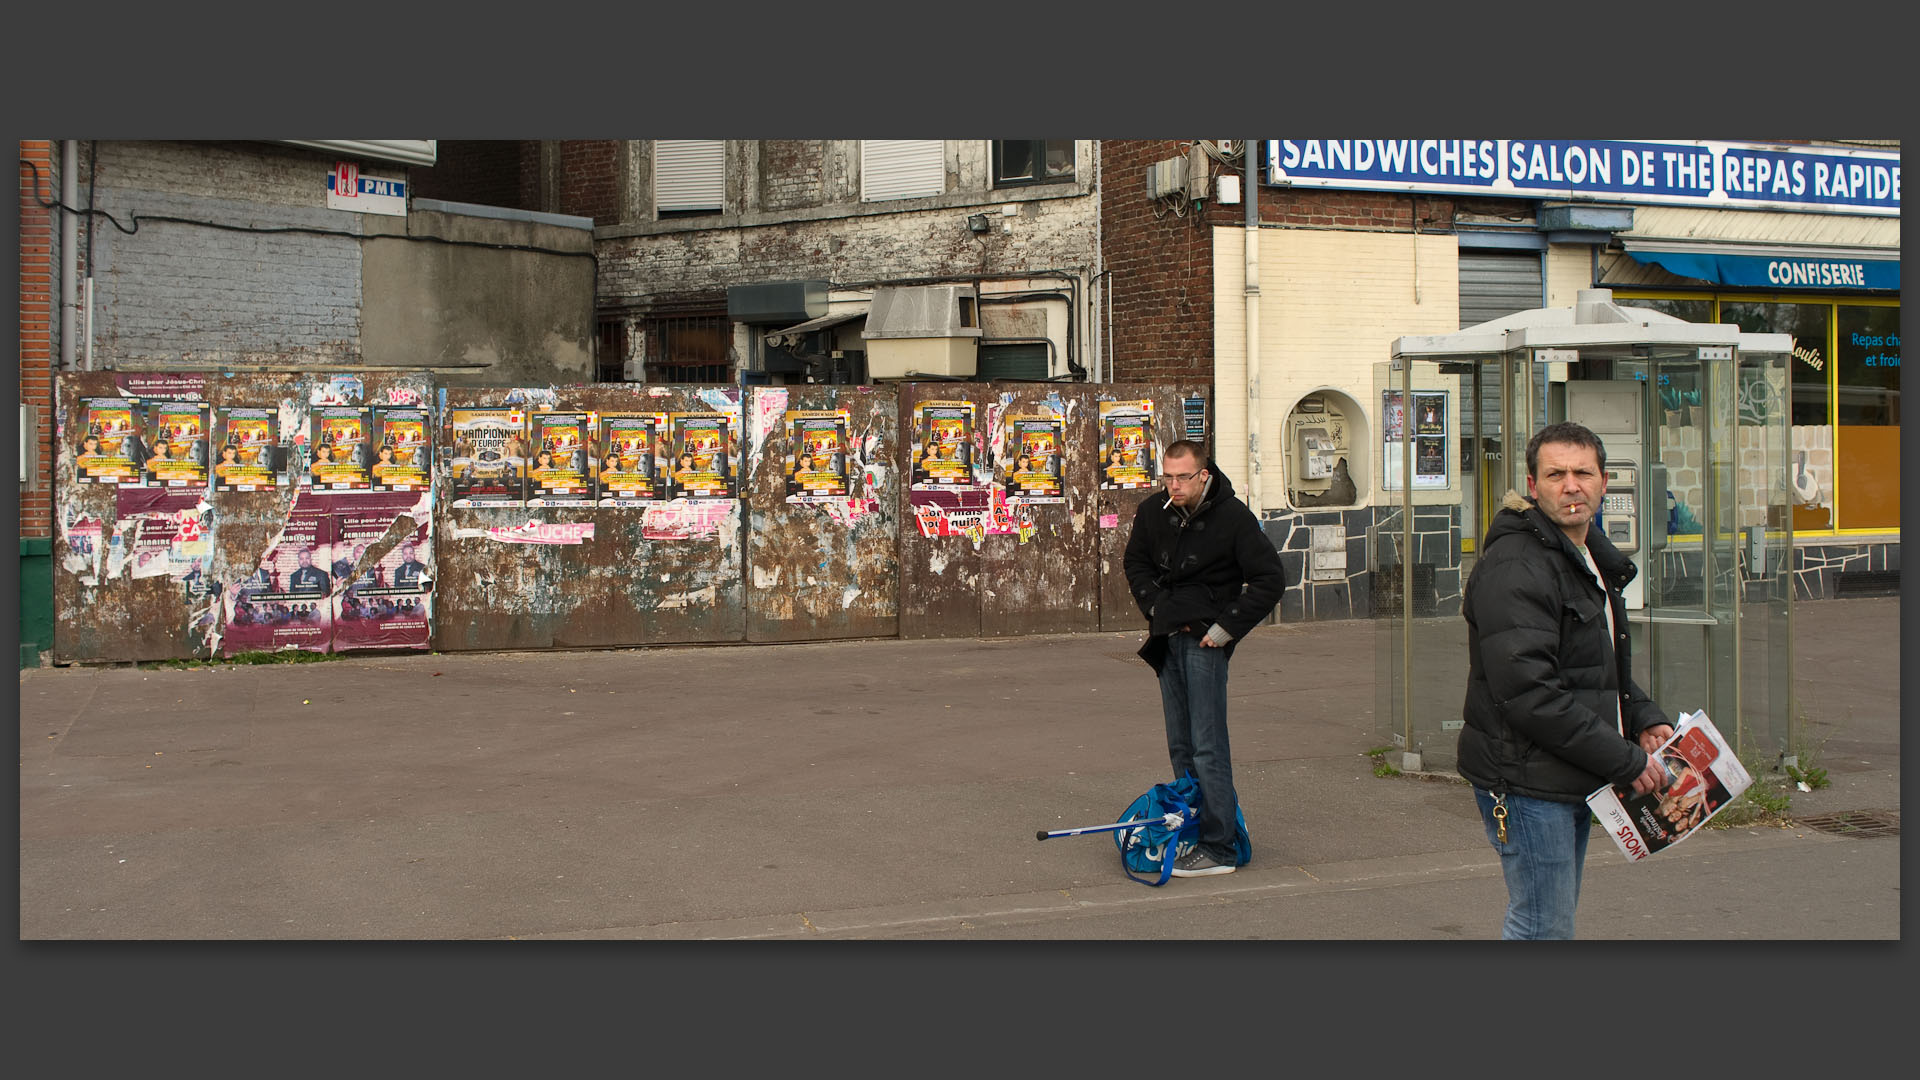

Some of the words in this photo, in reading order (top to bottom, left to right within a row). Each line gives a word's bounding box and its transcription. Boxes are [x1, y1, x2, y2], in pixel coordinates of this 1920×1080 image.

[1282, 140, 1496, 179] SANDWICHES
[1511, 142, 1611, 185] SALON
[1622, 149, 1655, 187] DE
[1662, 152, 1712, 190] THE
[364, 179, 398, 196] PML
[1725, 155, 1807, 196] REPAS
[1814, 162, 1900, 201] RAPIDE
[1768, 261, 1866, 286] CONFISERIE
[1852, 332, 1883, 350] Repas
[1865, 354, 1877, 367] et
